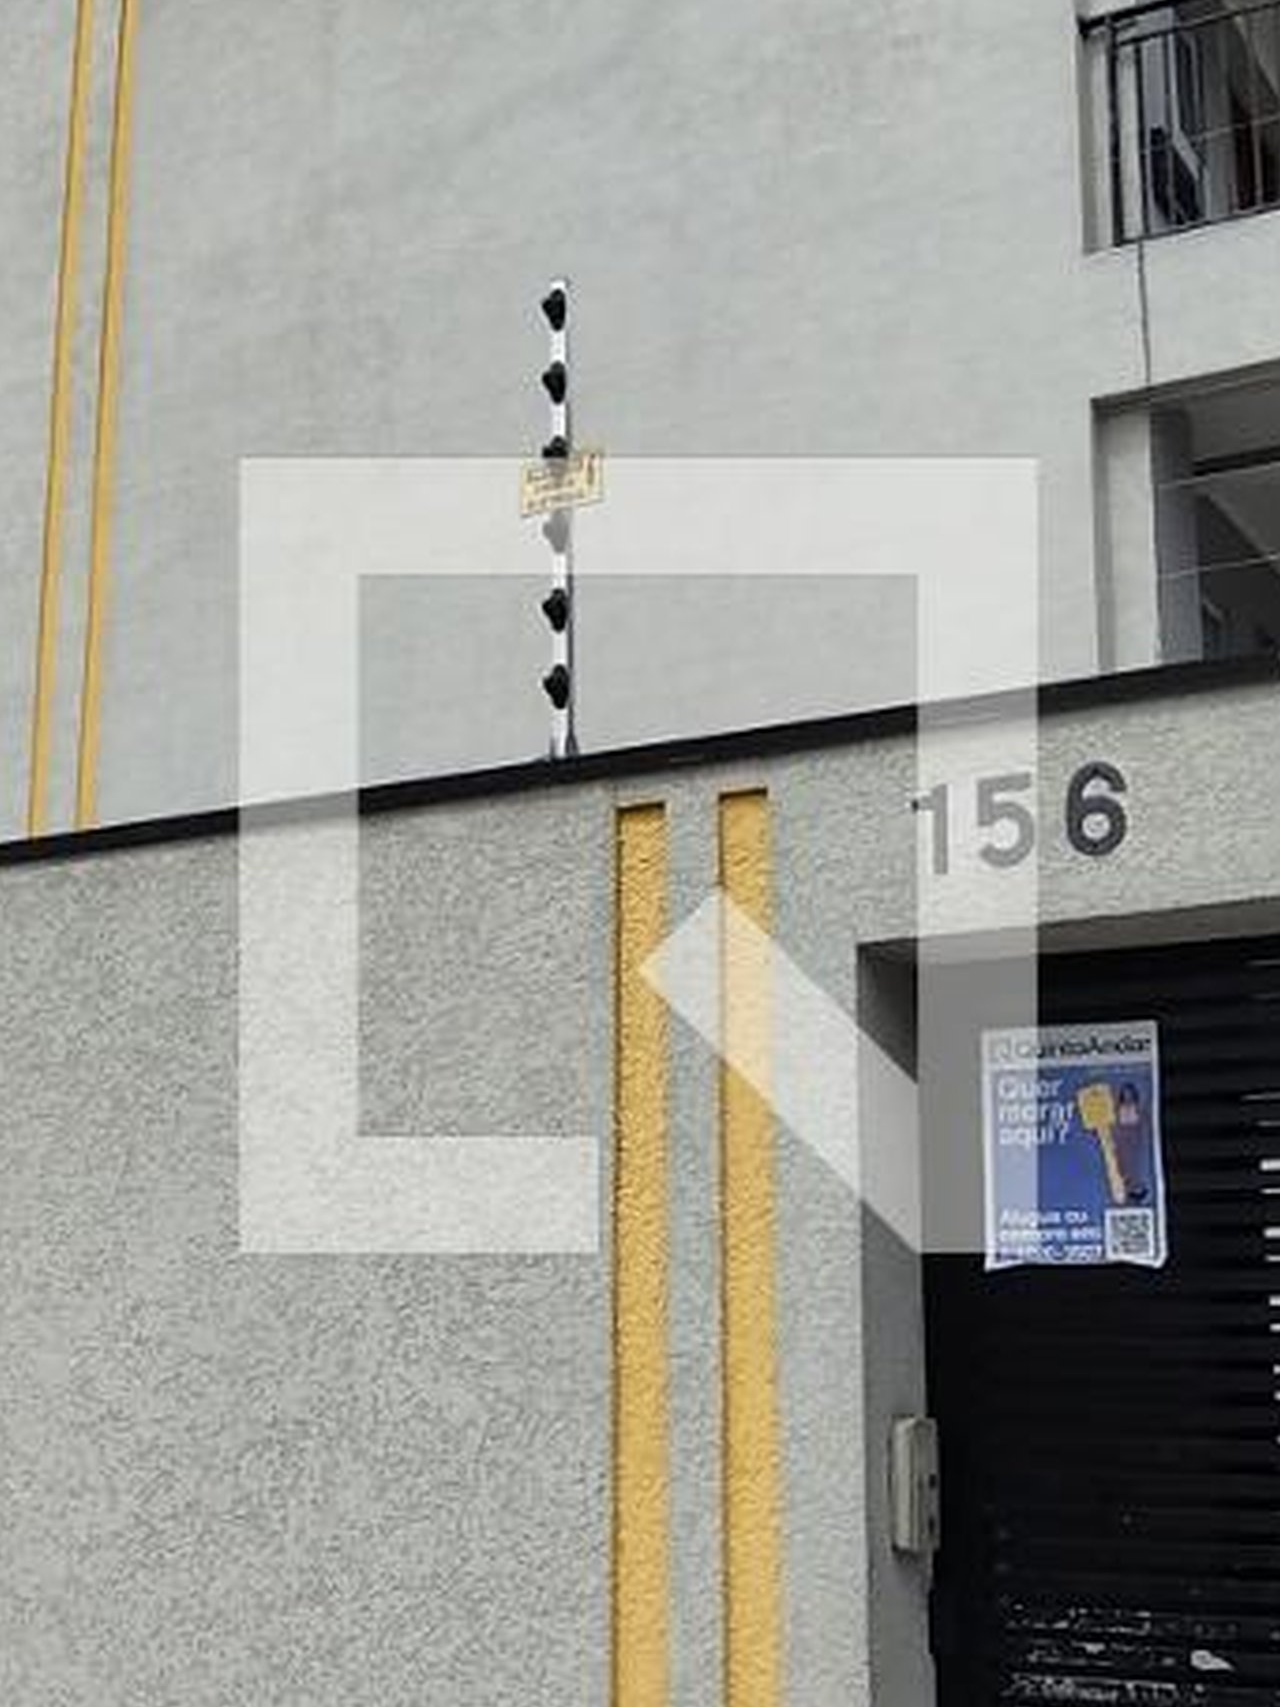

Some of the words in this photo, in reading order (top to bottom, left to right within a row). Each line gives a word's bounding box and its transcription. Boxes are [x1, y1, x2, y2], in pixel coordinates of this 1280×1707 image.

[910, 760, 1128, 875] 156
[998, 1076, 1063, 1099] Quer
[998, 1101, 1073, 1126] morar
[998, 1122, 1070, 1148] aqui?
